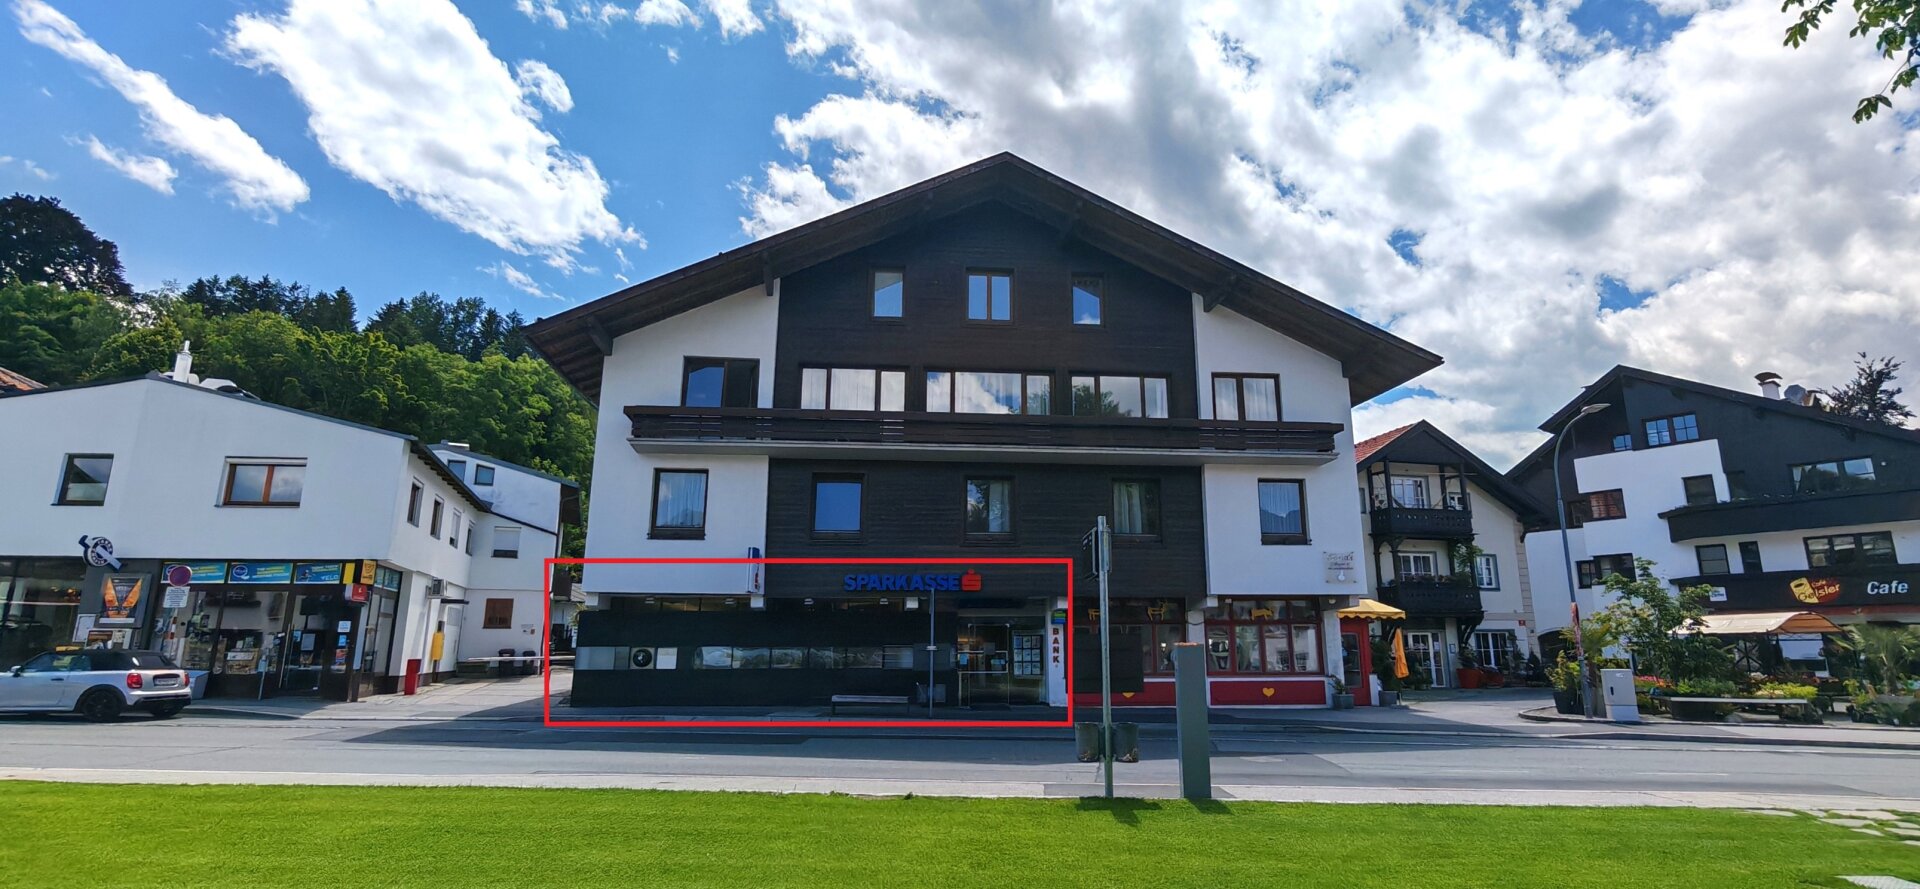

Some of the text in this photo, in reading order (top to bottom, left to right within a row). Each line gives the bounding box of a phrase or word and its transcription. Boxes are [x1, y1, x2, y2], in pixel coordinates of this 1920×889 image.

[844, 574, 960, 591] SPARKASSE
[1867, 581, 1908, 594] Cafe
[1798, 584, 1840, 600] Geisler
[1052, 627, 1060, 664] BANK
